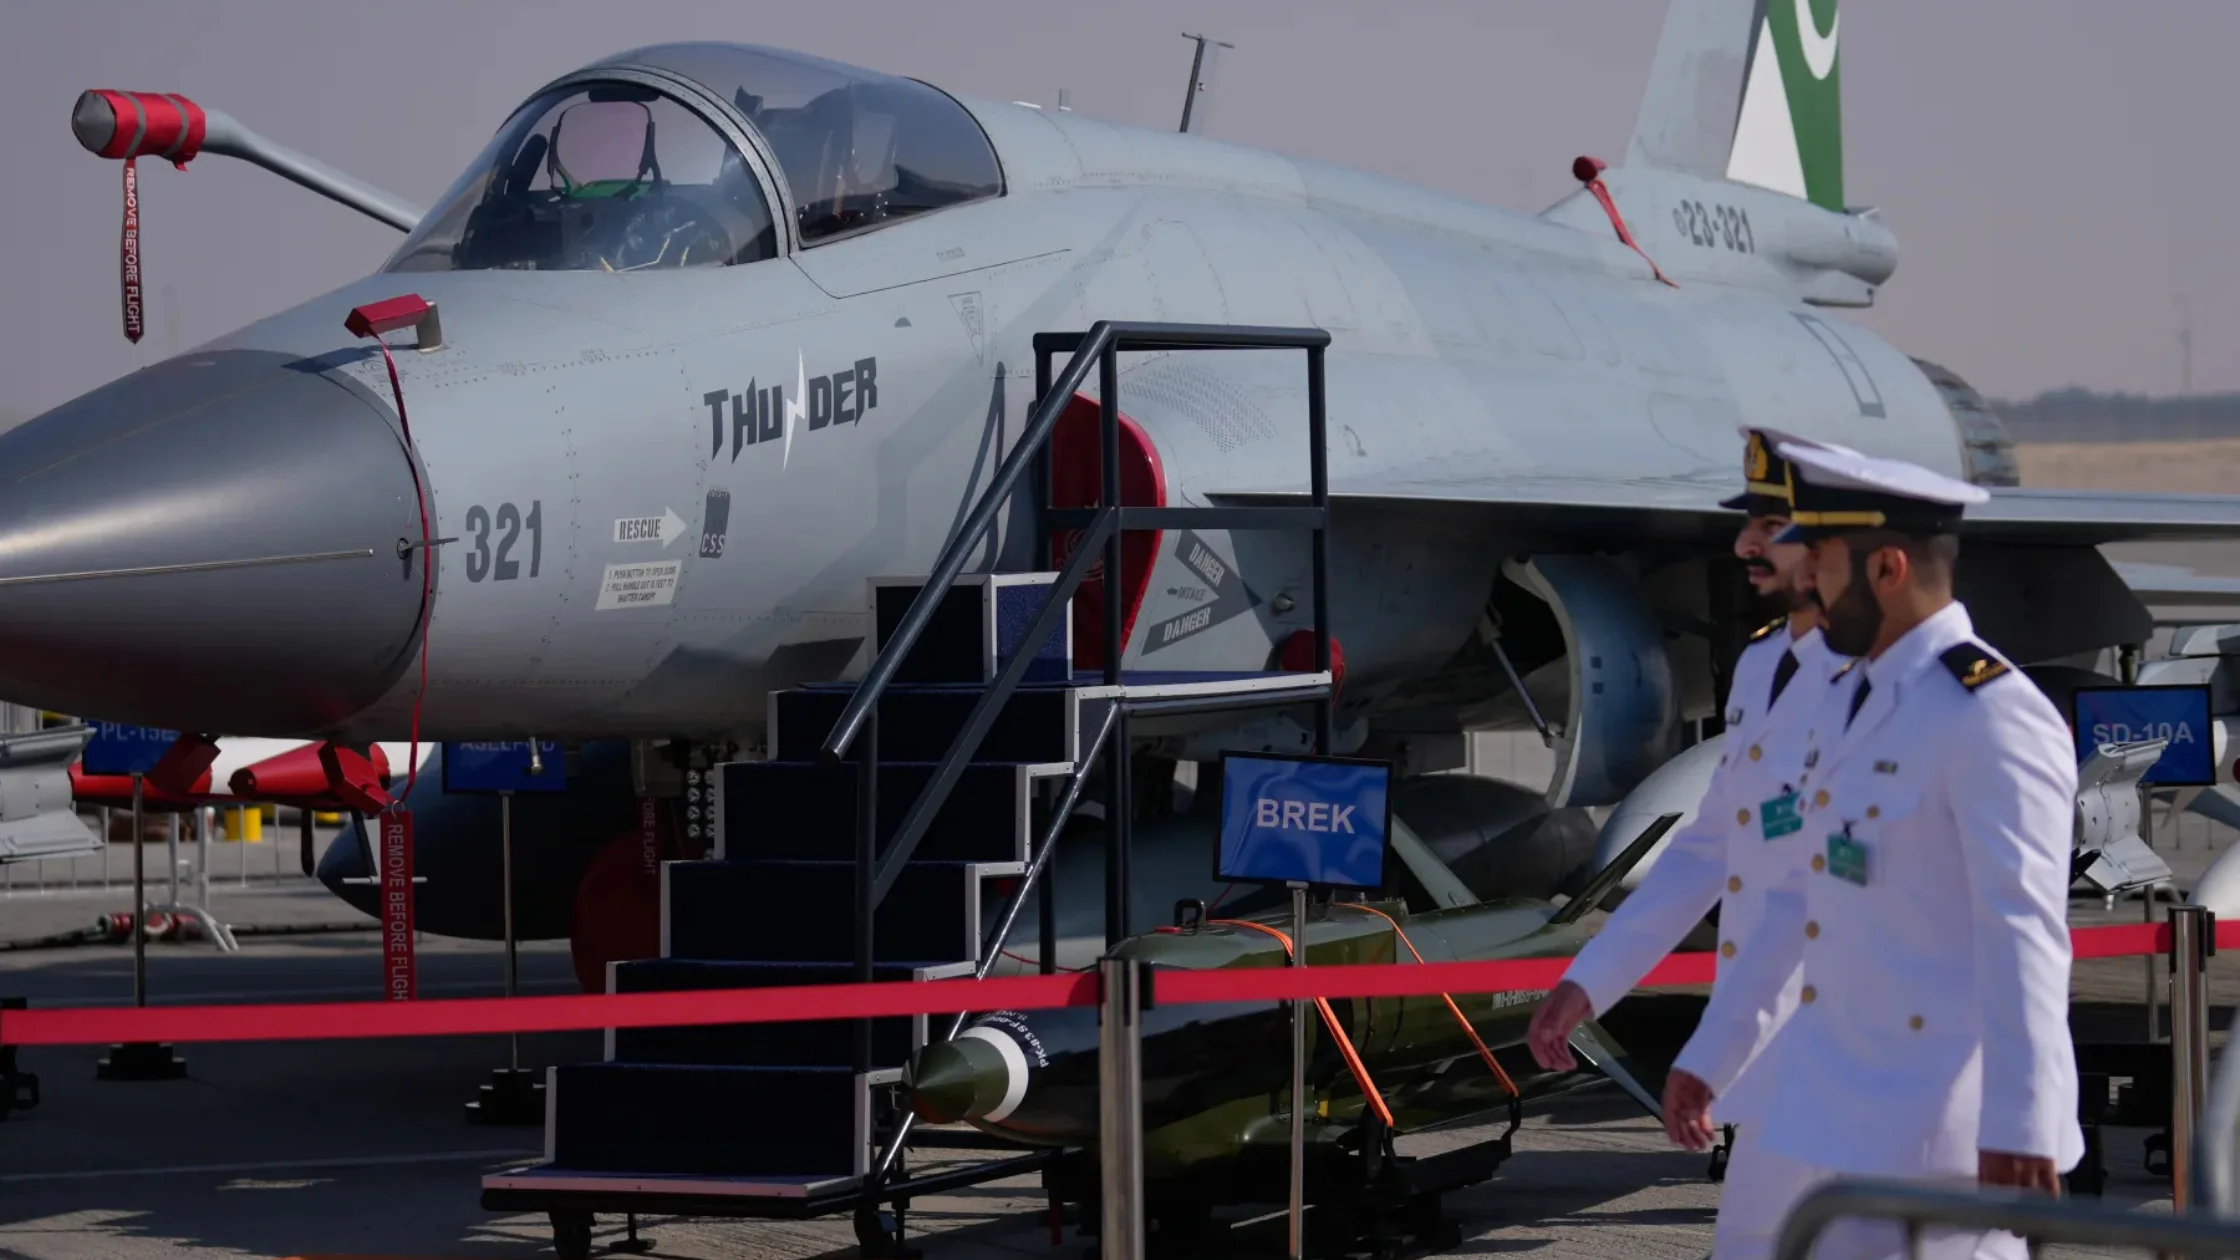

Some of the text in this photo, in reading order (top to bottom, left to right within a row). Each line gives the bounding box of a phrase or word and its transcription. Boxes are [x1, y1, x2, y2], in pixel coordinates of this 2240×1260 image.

[125, 168, 140, 332] REMOVE BEFORE FLIGHT
[703, 345, 877, 471] THUNDER
[466, 500, 541, 583] 321
[619, 518, 661, 540] RESCUE
[701, 533, 725, 553] CSS
[1188, 542, 1225, 587] DANGER
[1163, 607, 1211, 642] DANGER
[2093, 721, 2194, 745] SD-10A
[1256, 798, 1356, 834] BREK
[643, 832, 656, 875] FLIGHT
[388, 824, 409, 1002] REMOVE BEFORE FLIGH
